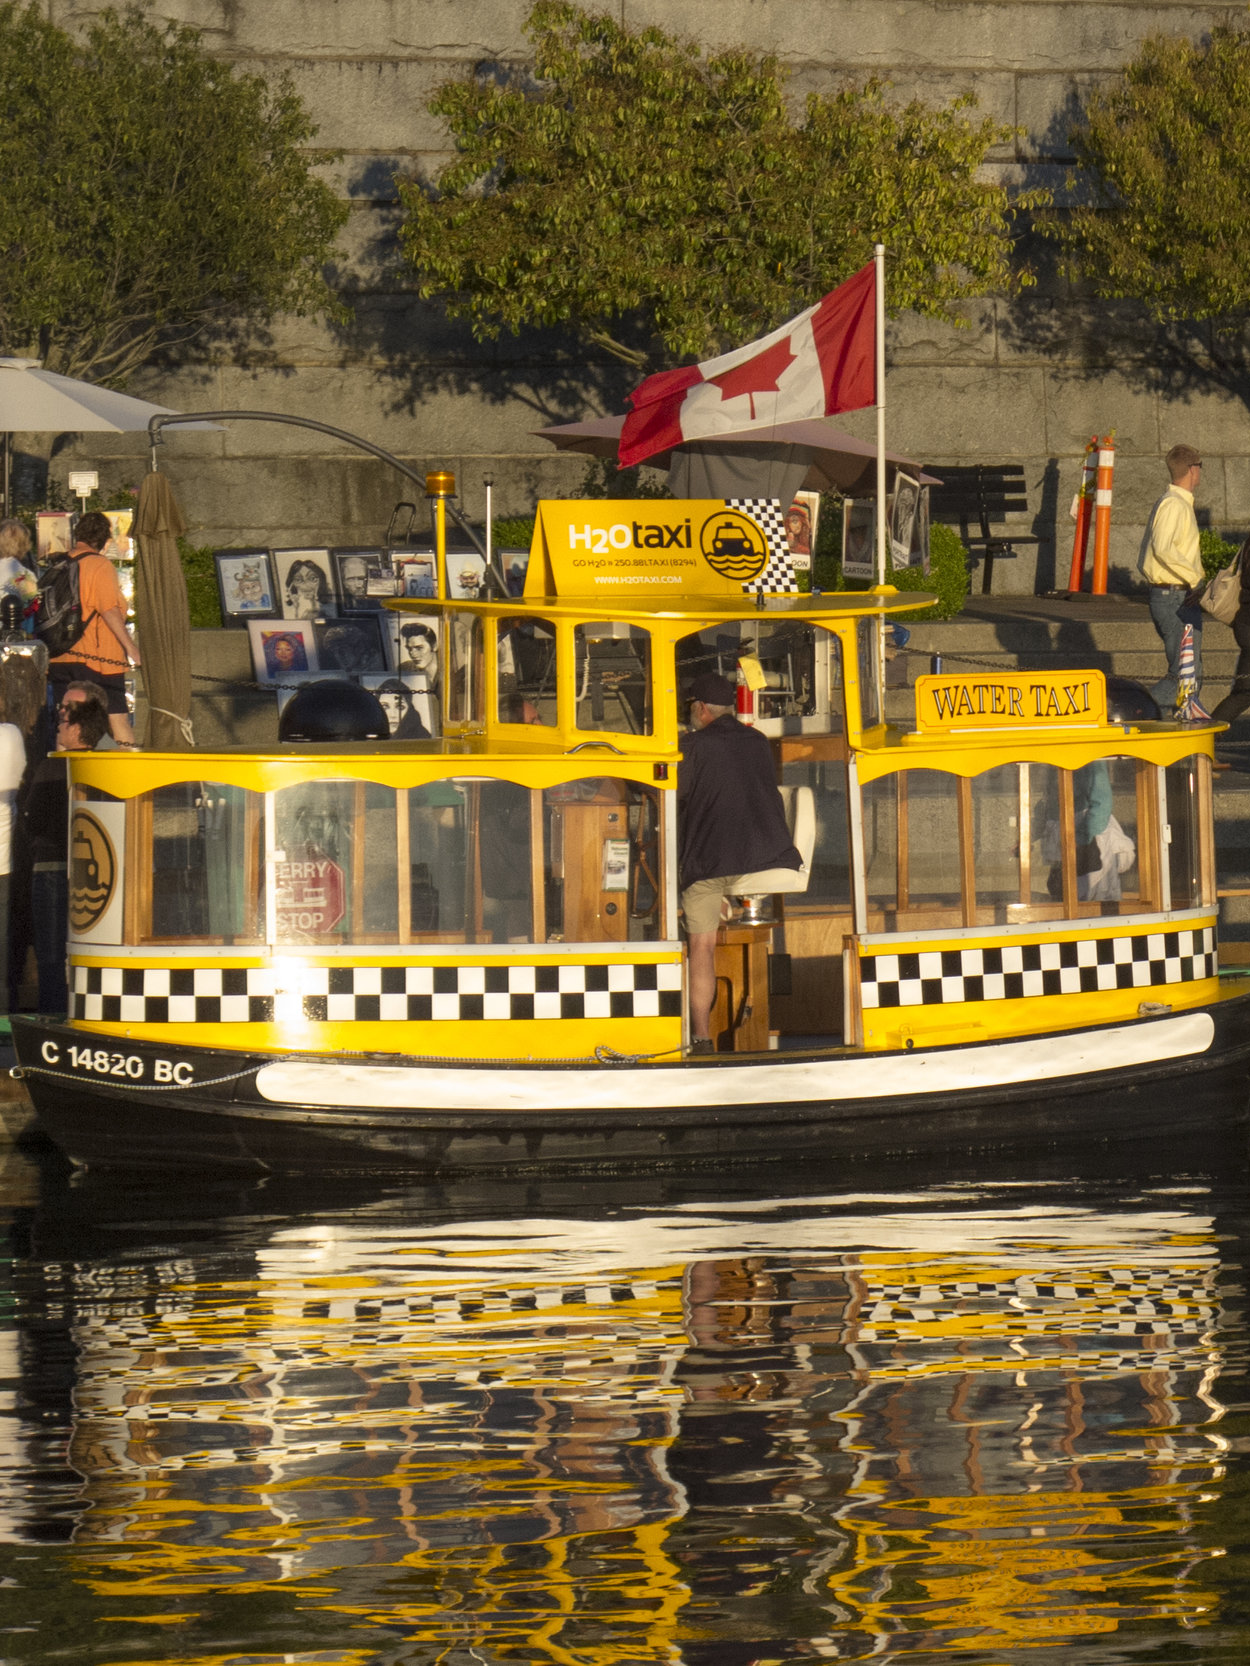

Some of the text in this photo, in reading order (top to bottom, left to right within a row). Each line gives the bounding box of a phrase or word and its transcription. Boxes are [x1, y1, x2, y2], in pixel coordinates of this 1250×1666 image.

[572, 559, 586, 567] GO
[669, 558, 697, 567] (8294)
[845, 566, 873, 575] CARTOON
[594, 575, 682, 584] WWW.H2OTAXI.COM
[932, 681, 1091, 720] WATER TAXI
[278, 861, 328, 879] ERRY
[276, 912, 324, 930] STOP
[41, 1040, 194, 1085] C 14820 BC
